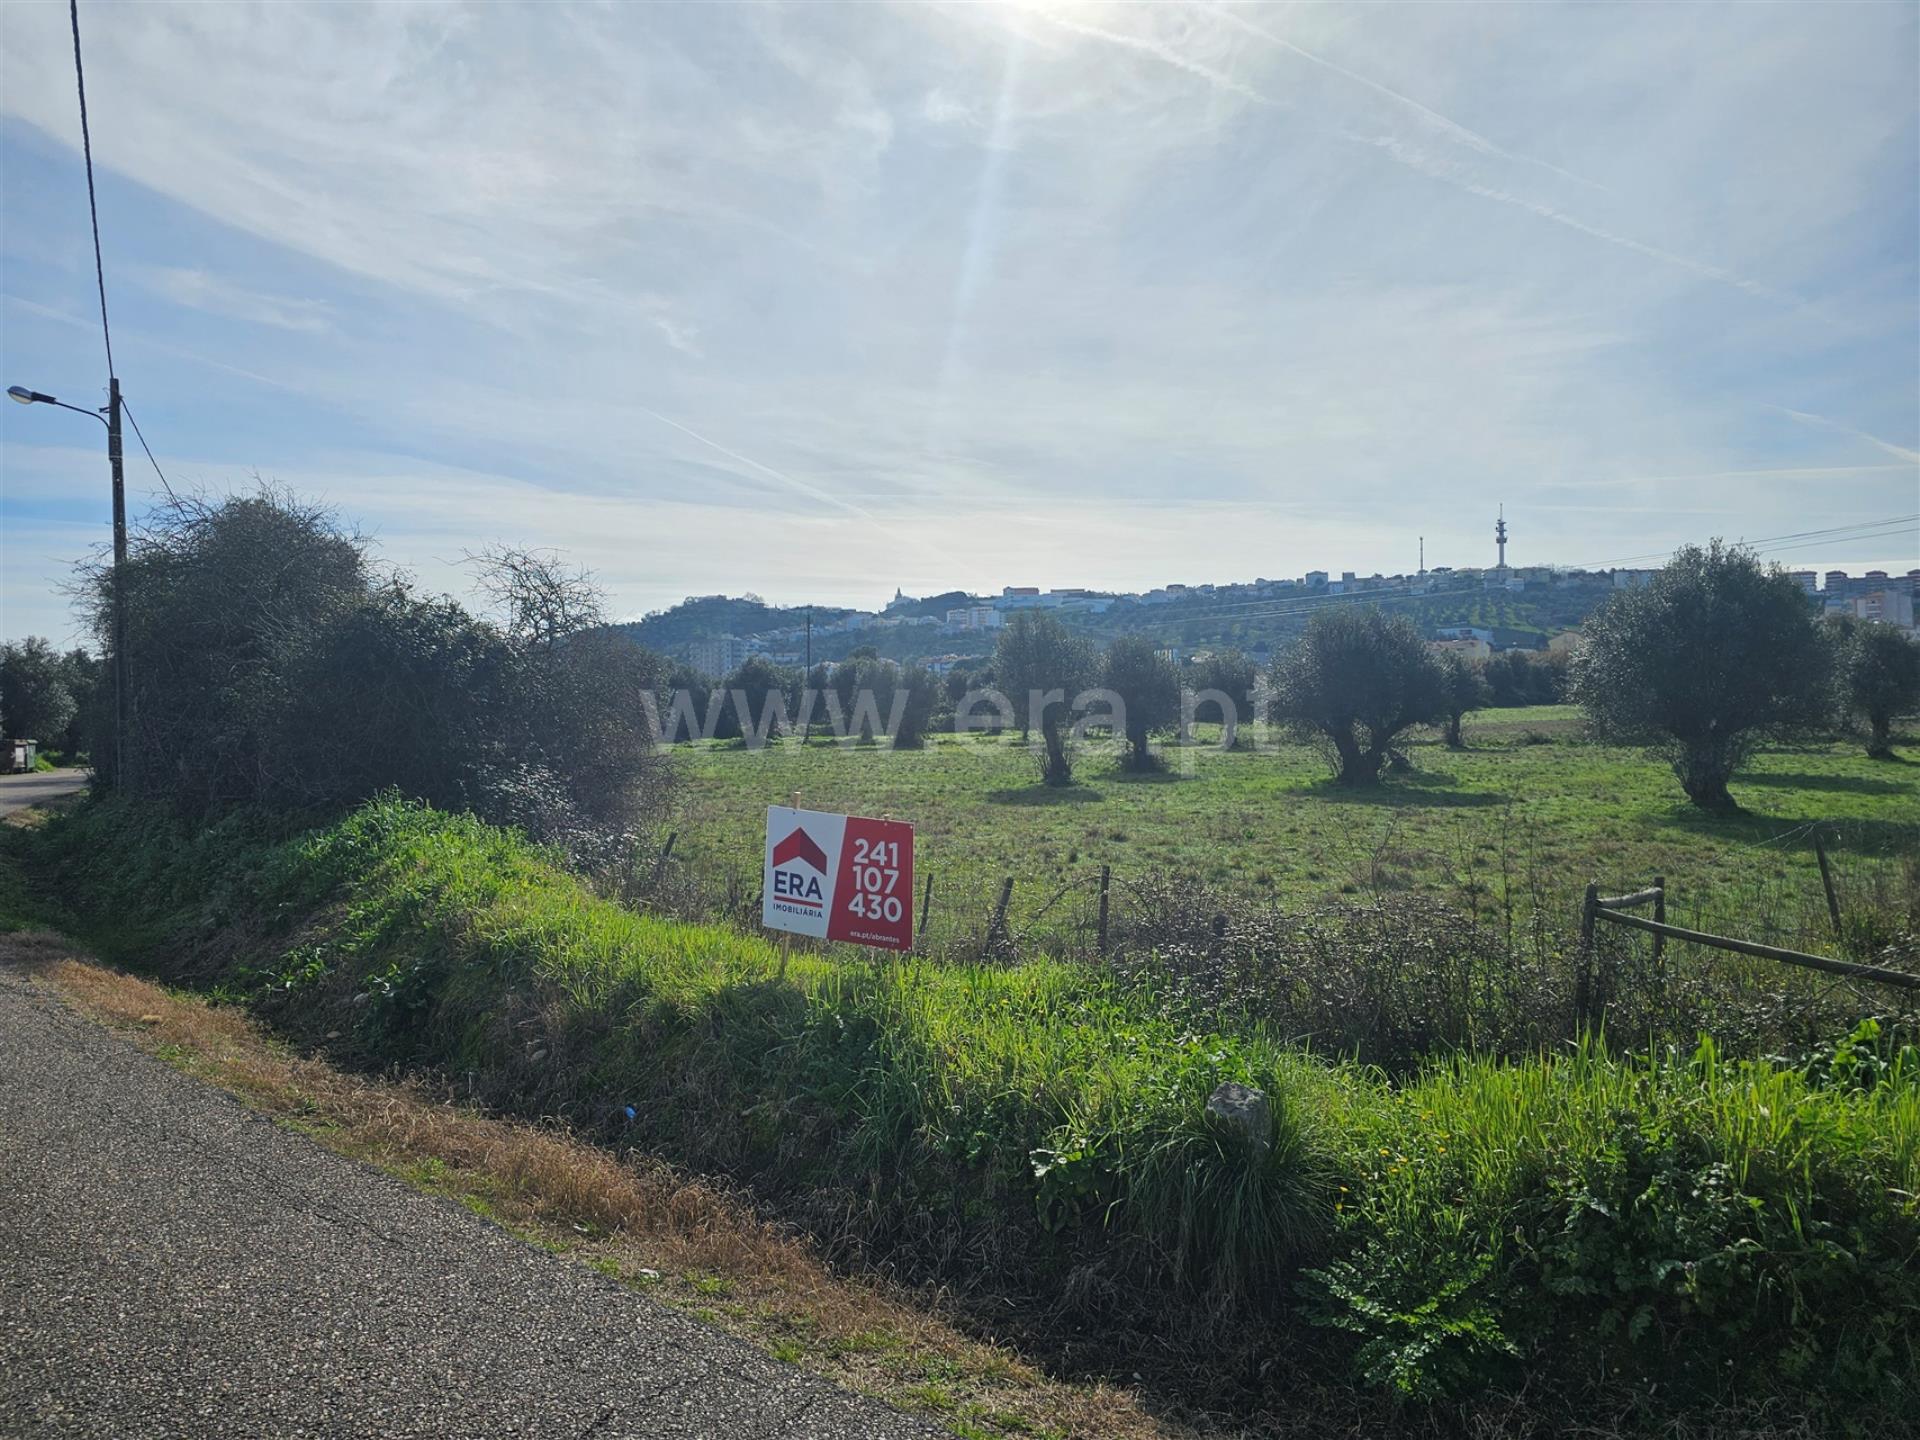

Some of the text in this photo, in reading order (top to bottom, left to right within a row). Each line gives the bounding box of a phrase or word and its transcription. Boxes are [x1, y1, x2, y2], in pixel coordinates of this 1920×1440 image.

[854, 838, 898, 867] 241
[774, 870, 823, 900] ERA
[853, 865, 899, 894] 107
[773, 904, 823, 918] IMOBILIÁRIA
[848, 893, 902, 922] 430
[850, 930, 900, 943] era.pt/abrantes
